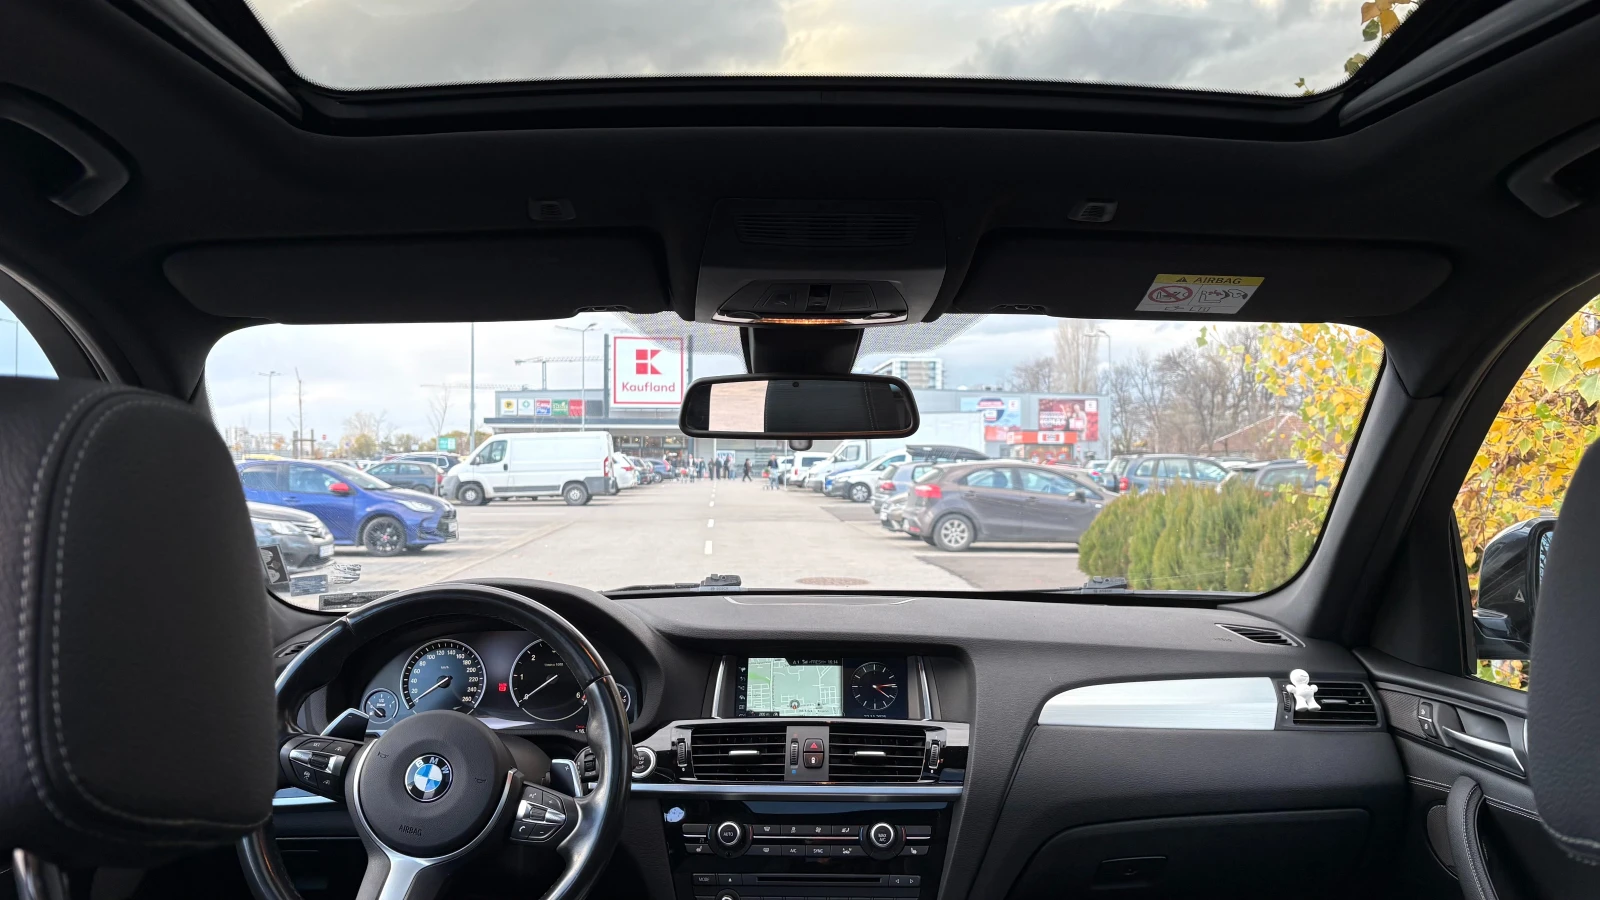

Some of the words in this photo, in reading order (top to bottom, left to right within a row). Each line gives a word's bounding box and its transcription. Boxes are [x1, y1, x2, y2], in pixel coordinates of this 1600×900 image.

[1193, 276, 1243, 285] AIRBAG
[621, 381, 676, 393] Kaufland
[415, 756, 449, 774] BMW
[399, 824, 423, 837] AIRBAG
